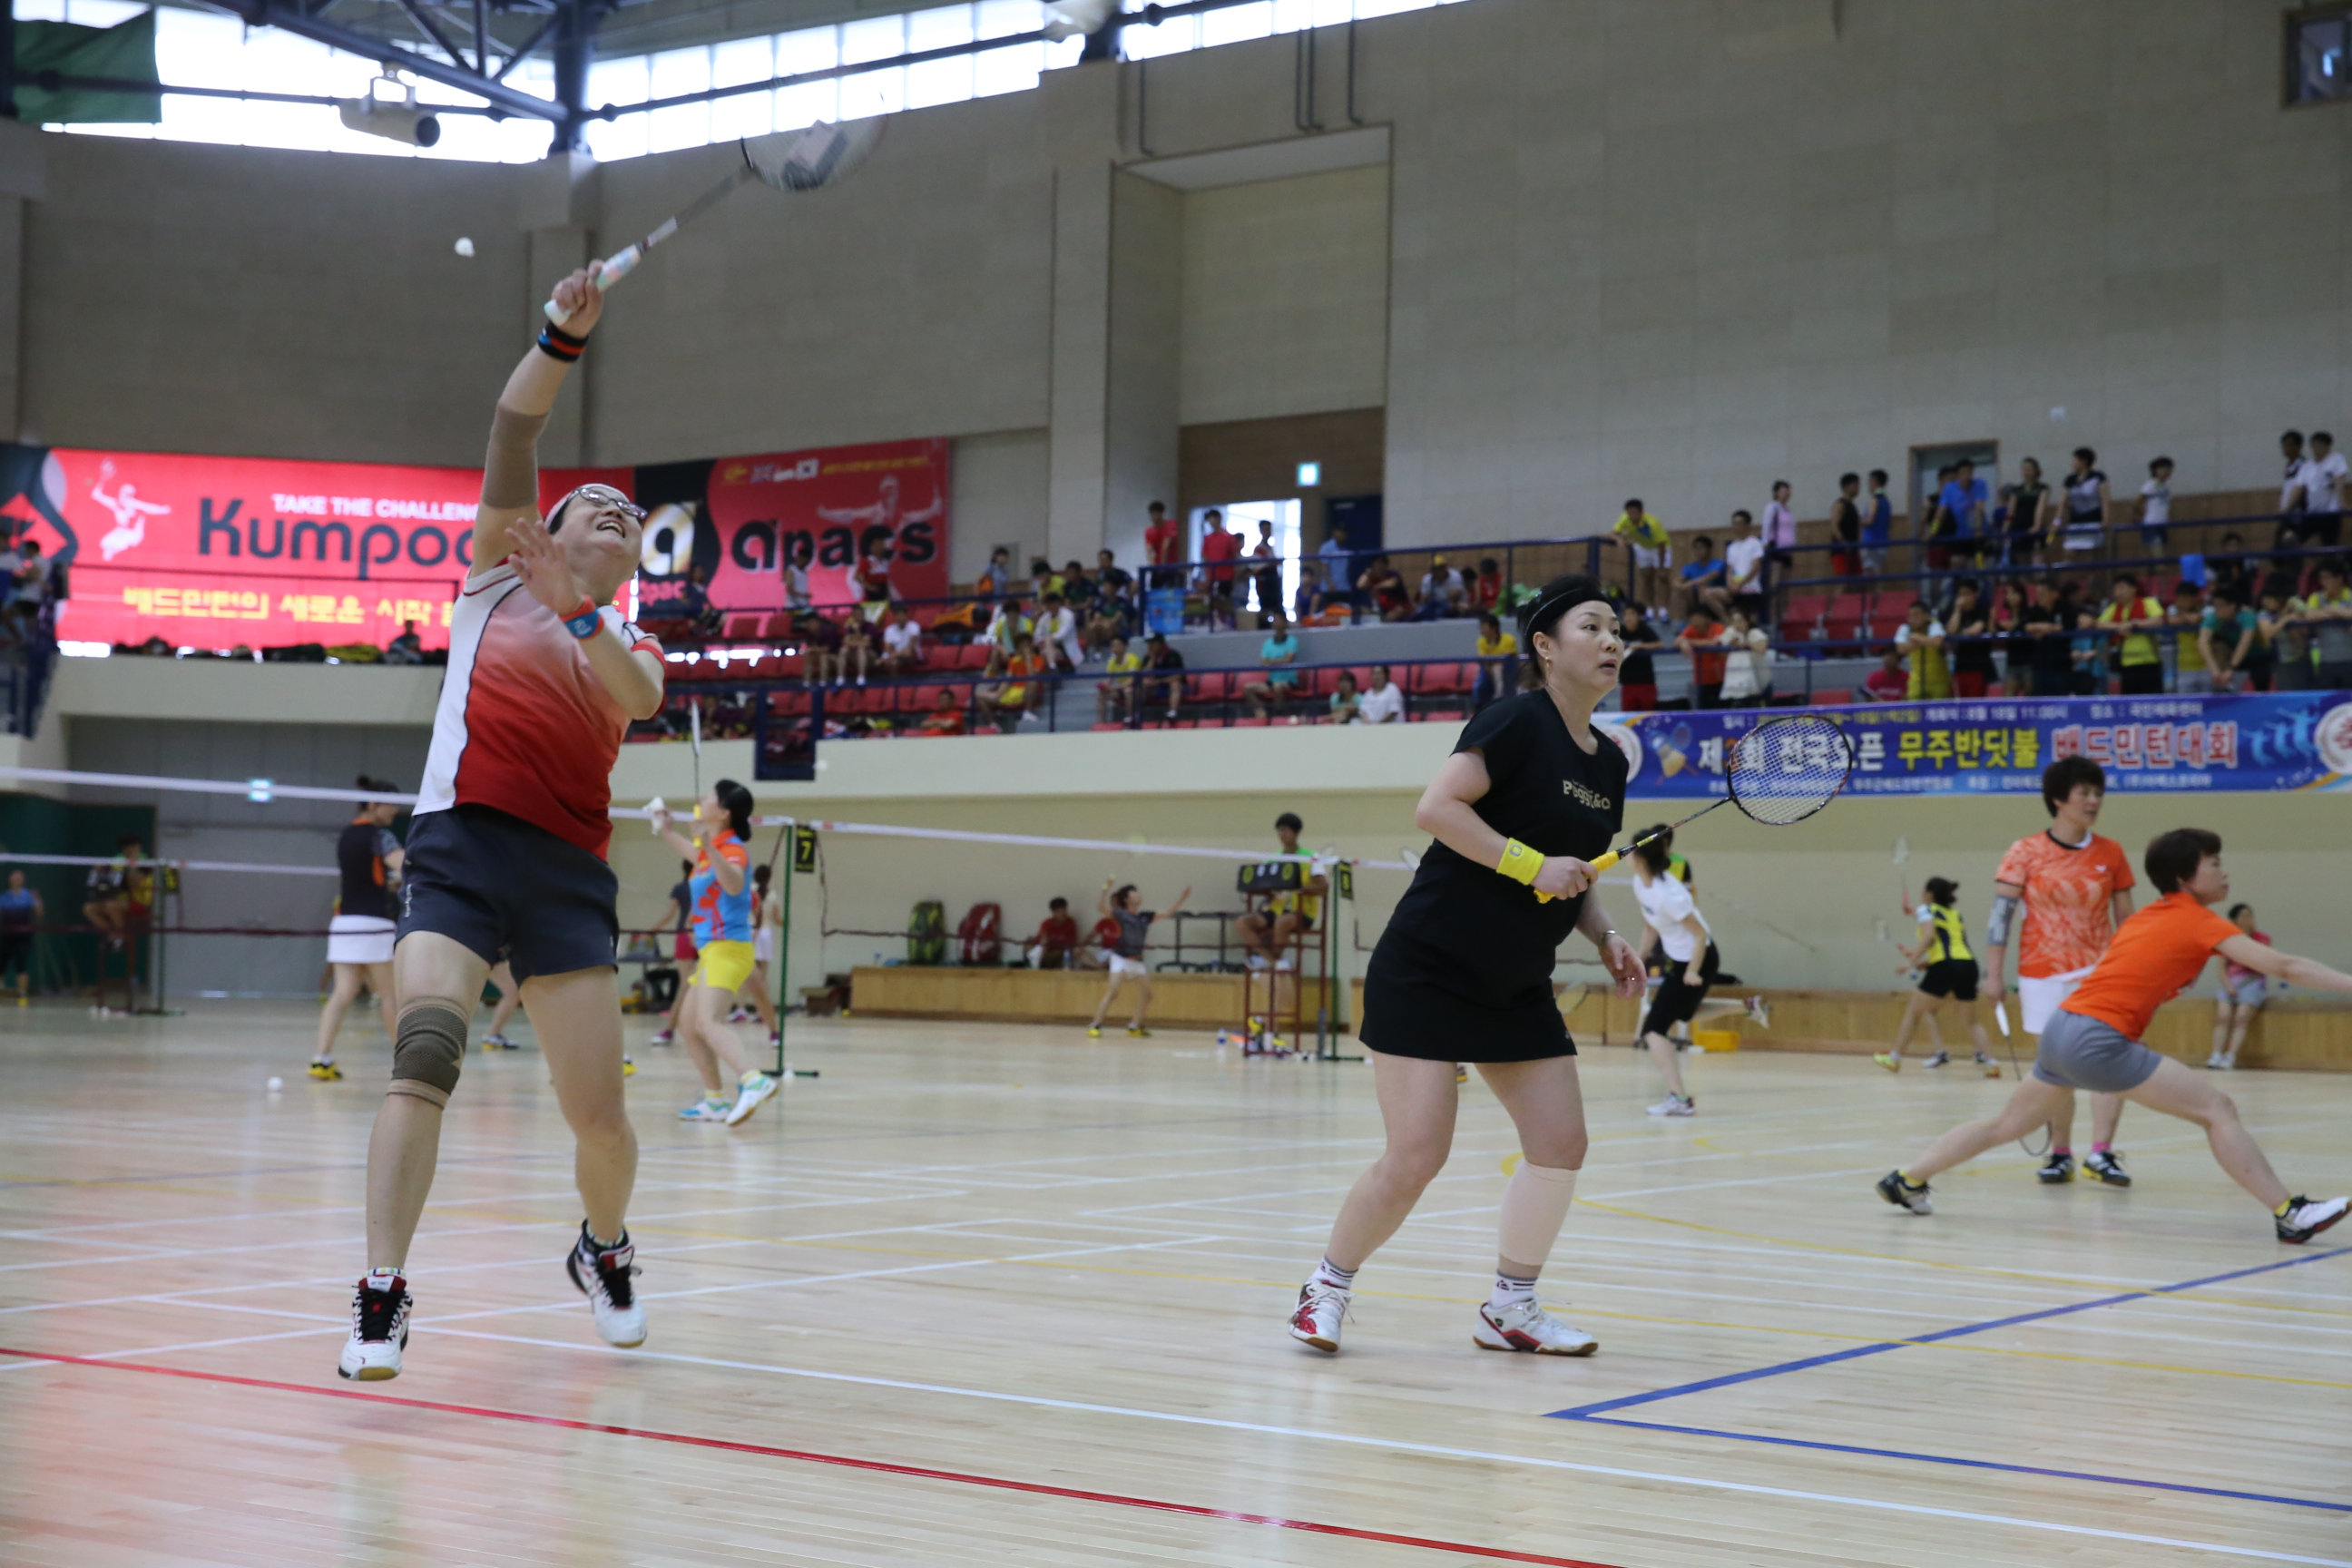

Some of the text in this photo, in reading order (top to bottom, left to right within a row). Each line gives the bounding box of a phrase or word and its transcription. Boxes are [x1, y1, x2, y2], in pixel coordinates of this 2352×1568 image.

[272, 494, 328, 515] TAKE
[330, 496, 372, 517] THE
[123, 586, 270, 620] 배드민턴의
[279, 593, 365, 624] 새로운
[376, 598, 432, 627] 시작
[1897, 727, 2040, 770] 무주반딧불
[2051, 720, 2239, 770] 배드민턴대회
[801, 840, 812, 861] 7
